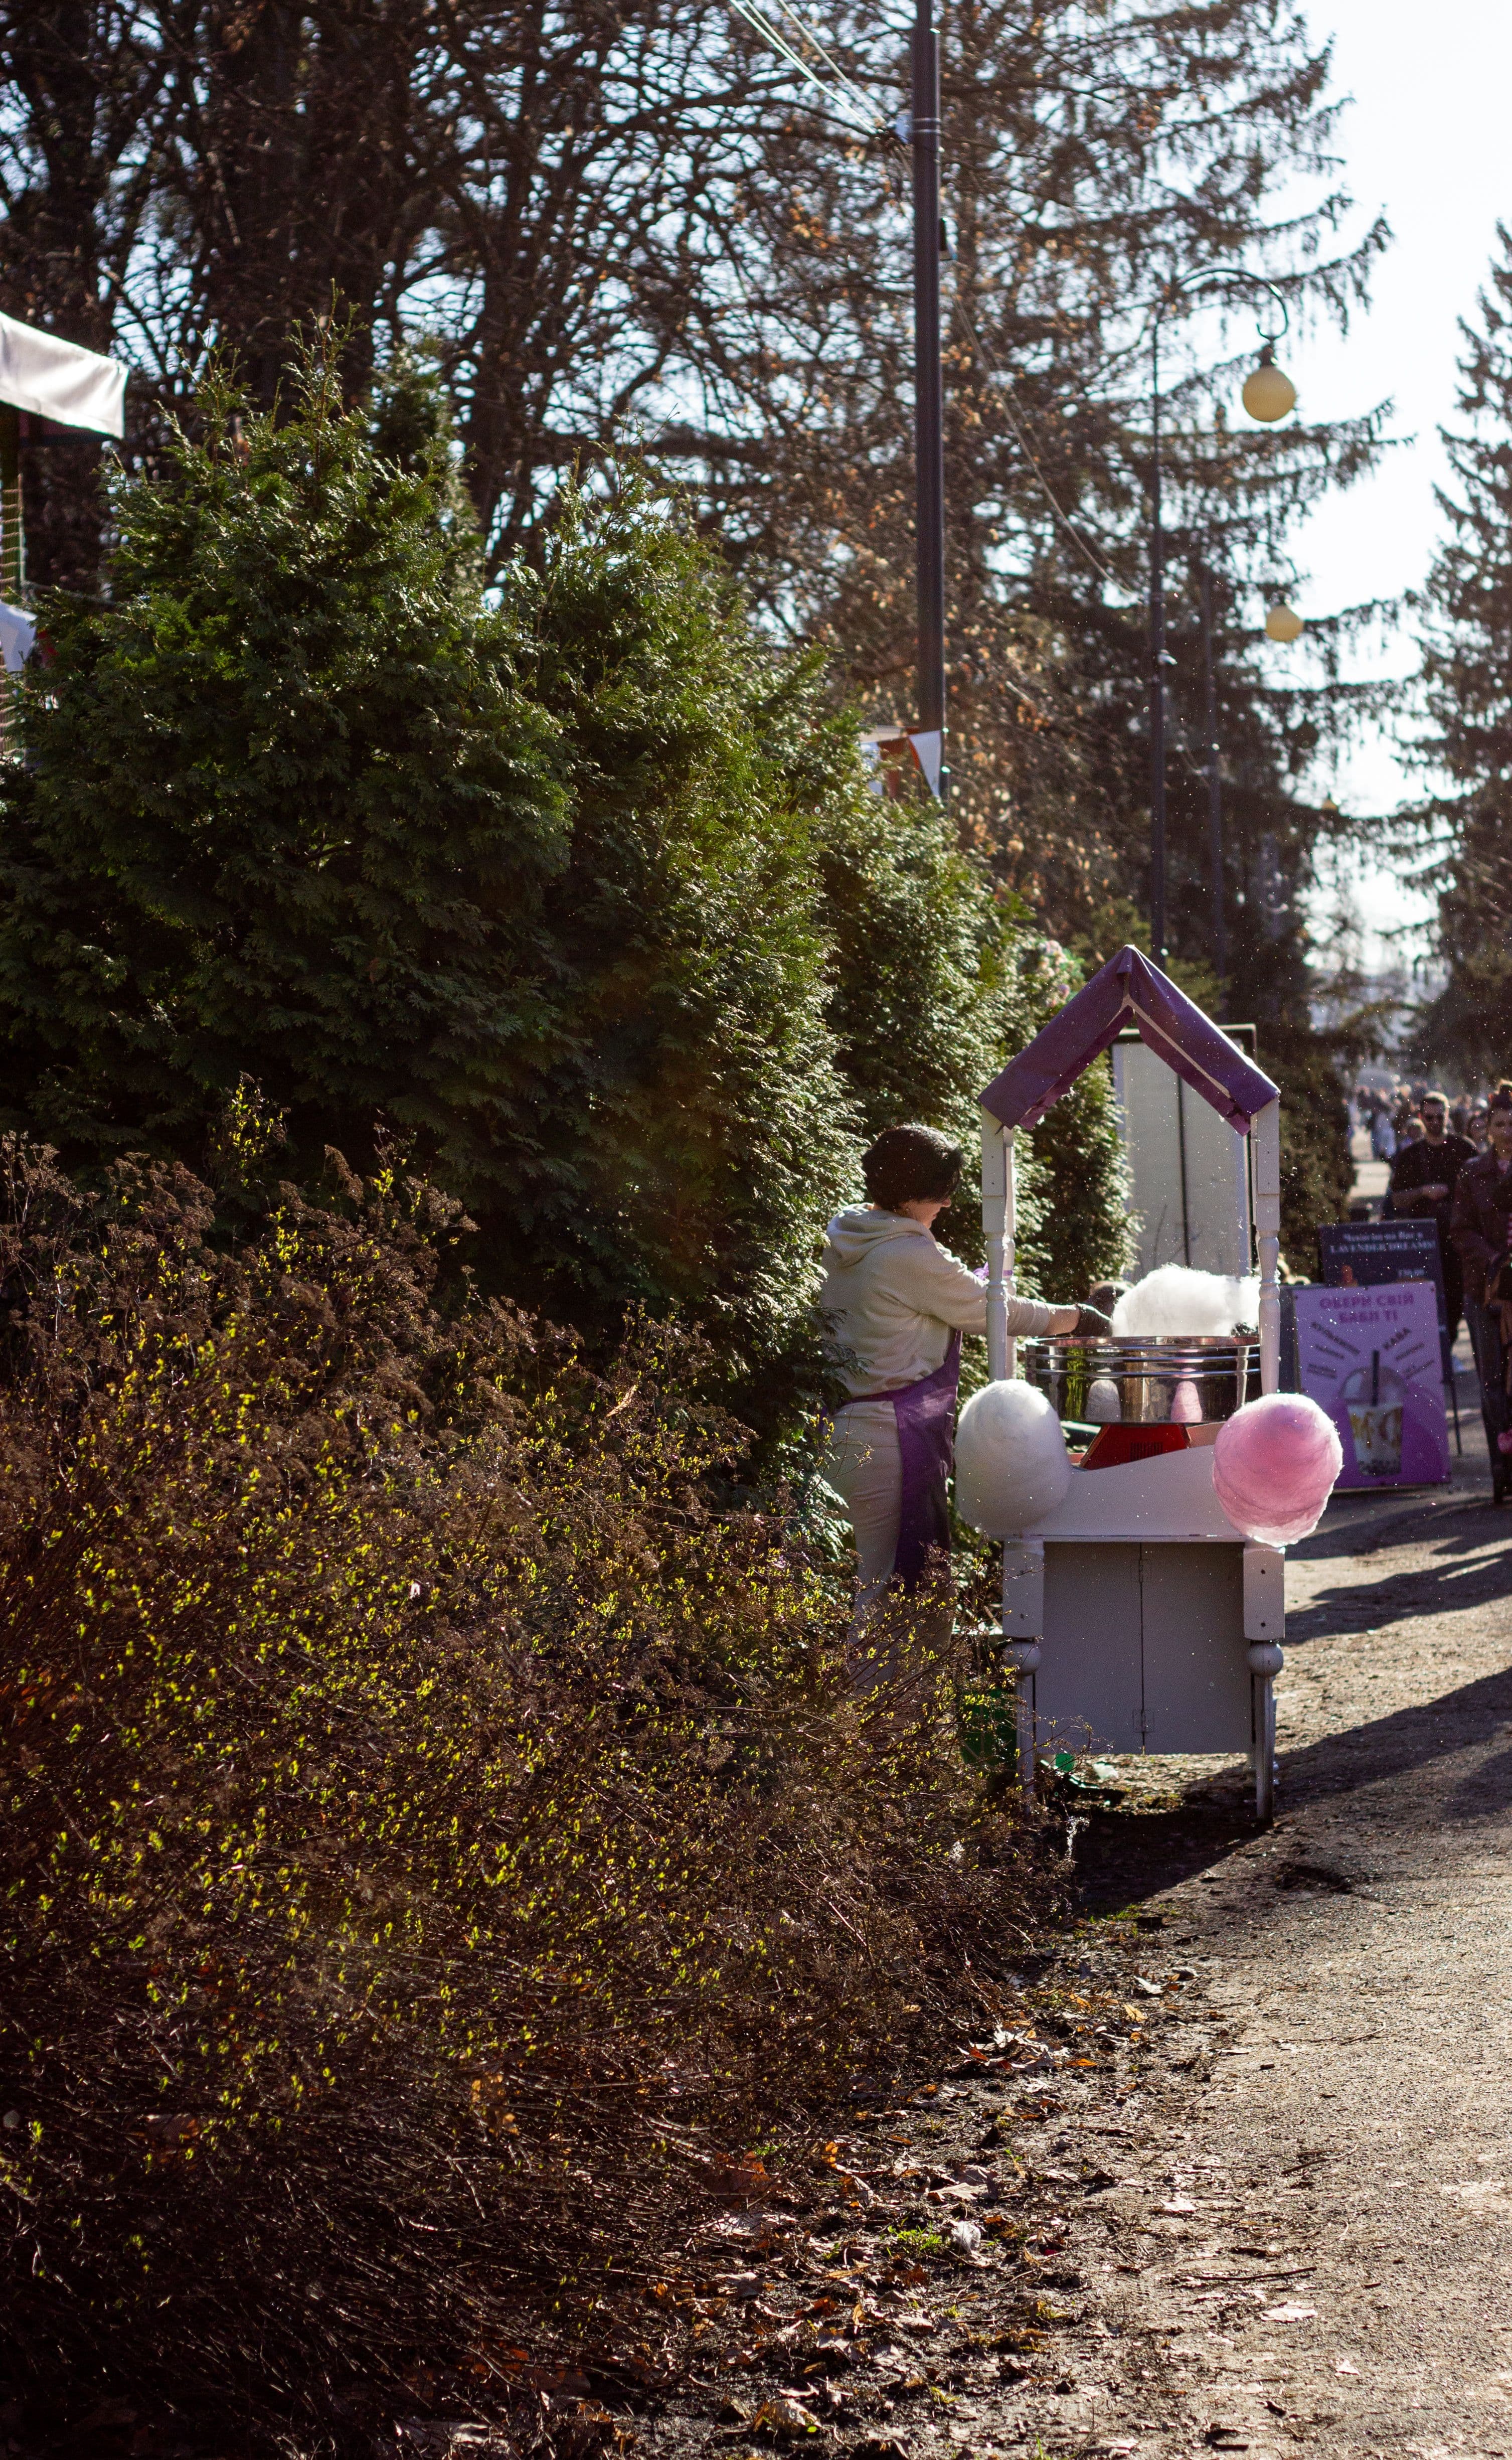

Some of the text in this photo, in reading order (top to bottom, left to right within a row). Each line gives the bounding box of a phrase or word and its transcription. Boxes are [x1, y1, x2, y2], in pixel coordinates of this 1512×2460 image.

[1319, 1291, 1414, 1309] ОБЕРИ СВІЙ
[1383, 1309, 1399, 1322] ТІ
